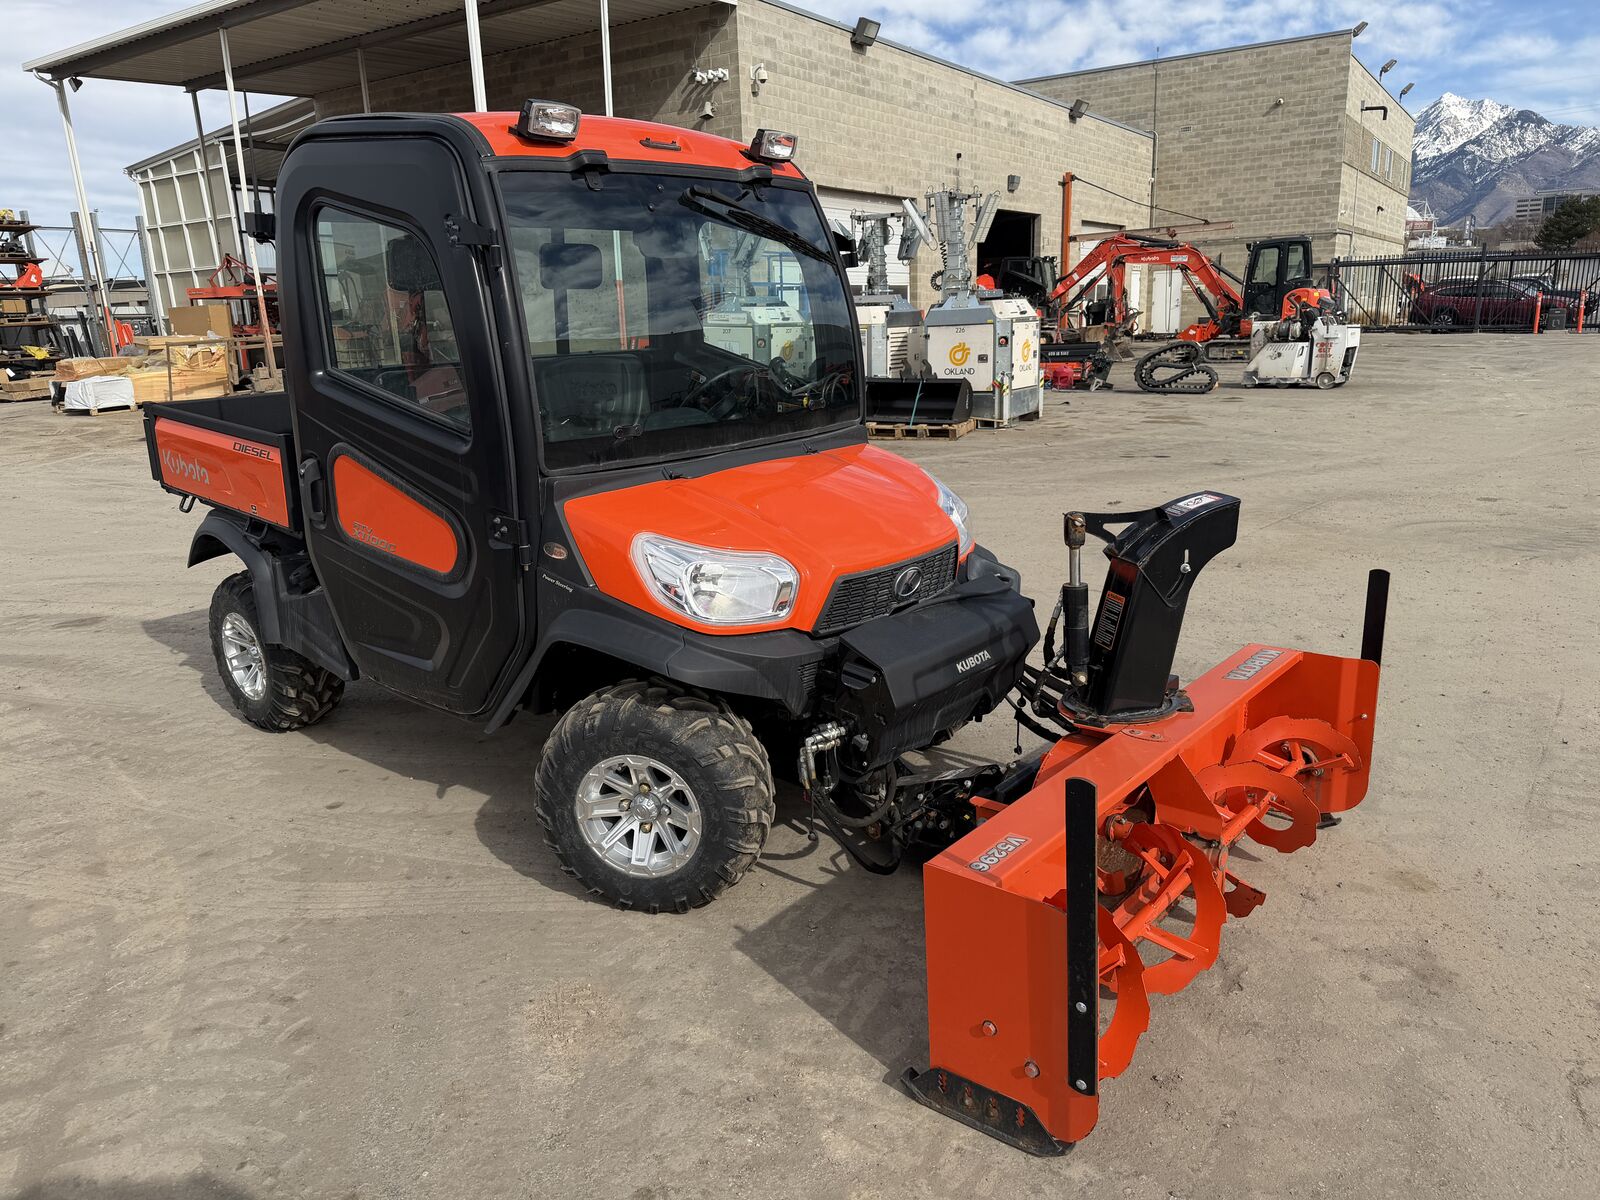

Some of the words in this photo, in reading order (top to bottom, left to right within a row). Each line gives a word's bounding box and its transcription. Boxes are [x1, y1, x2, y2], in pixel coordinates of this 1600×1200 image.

[943, 367, 975, 376] OKLAND
[233, 441, 274, 461] DIESEL
[162, 449, 209, 485] Kubota
[956, 649, 992, 673] KUBOTA
[1223, 649, 1285, 680] KUBOTA
[969, 836, 1028, 873] V5296
